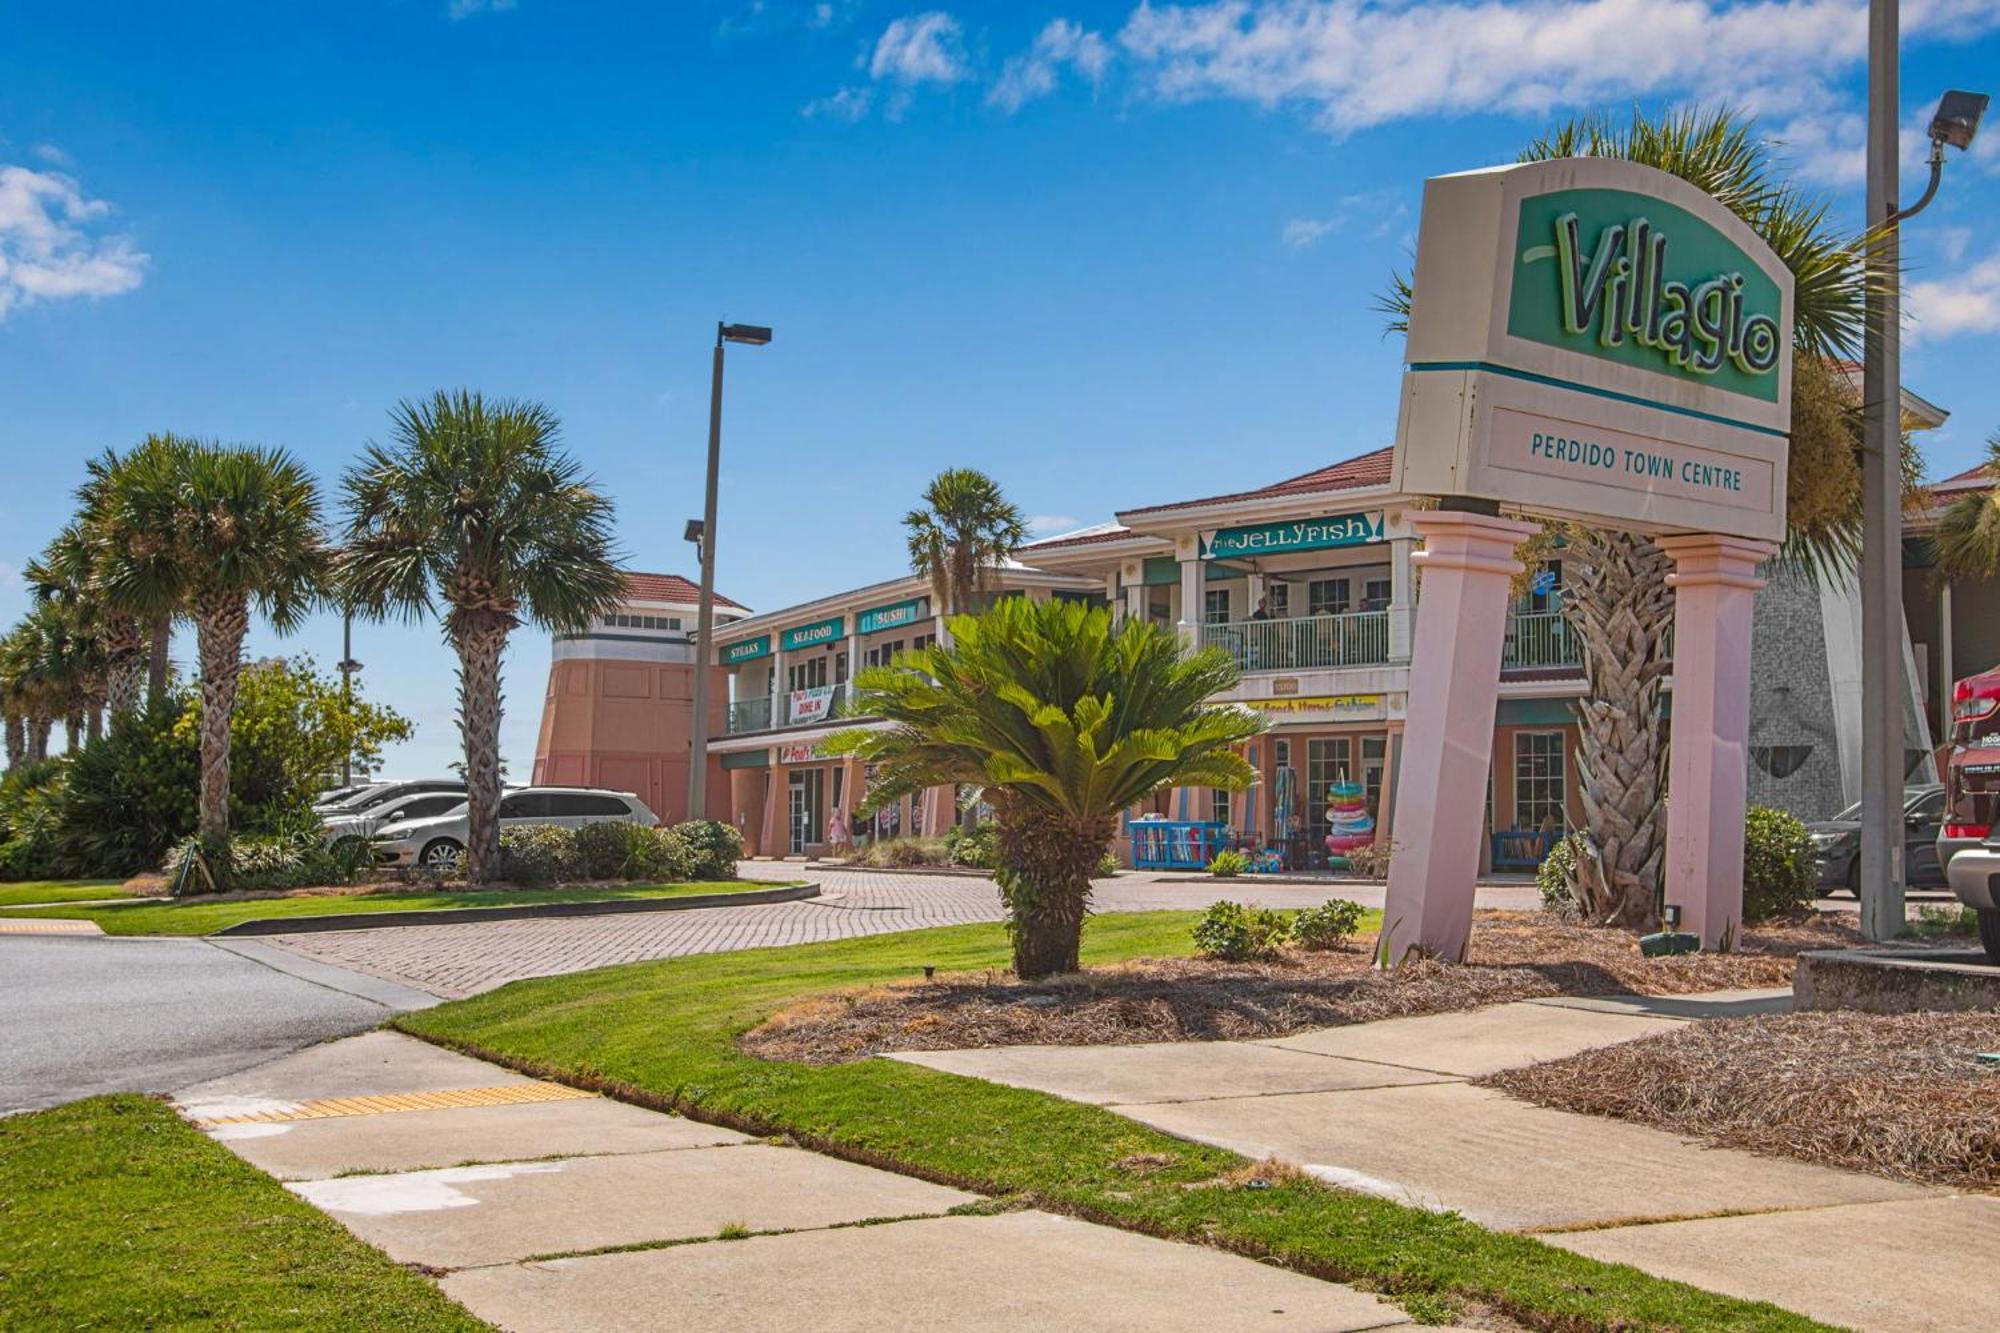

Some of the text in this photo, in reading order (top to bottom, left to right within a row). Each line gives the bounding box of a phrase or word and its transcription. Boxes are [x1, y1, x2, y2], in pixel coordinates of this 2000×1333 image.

[1555, 211, 1781, 375] Villagio
[1531, 433, 1741, 491] PERDIDO TOWN CENTRE
[878, 607, 906, 625] SUSHI
[792, 625, 832, 644] SEAFOOD
[730, 641, 759, 658] STEAKS
[799, 699, 822, 715] DINE IN
[1264, 701, 1295, 714] Beach
